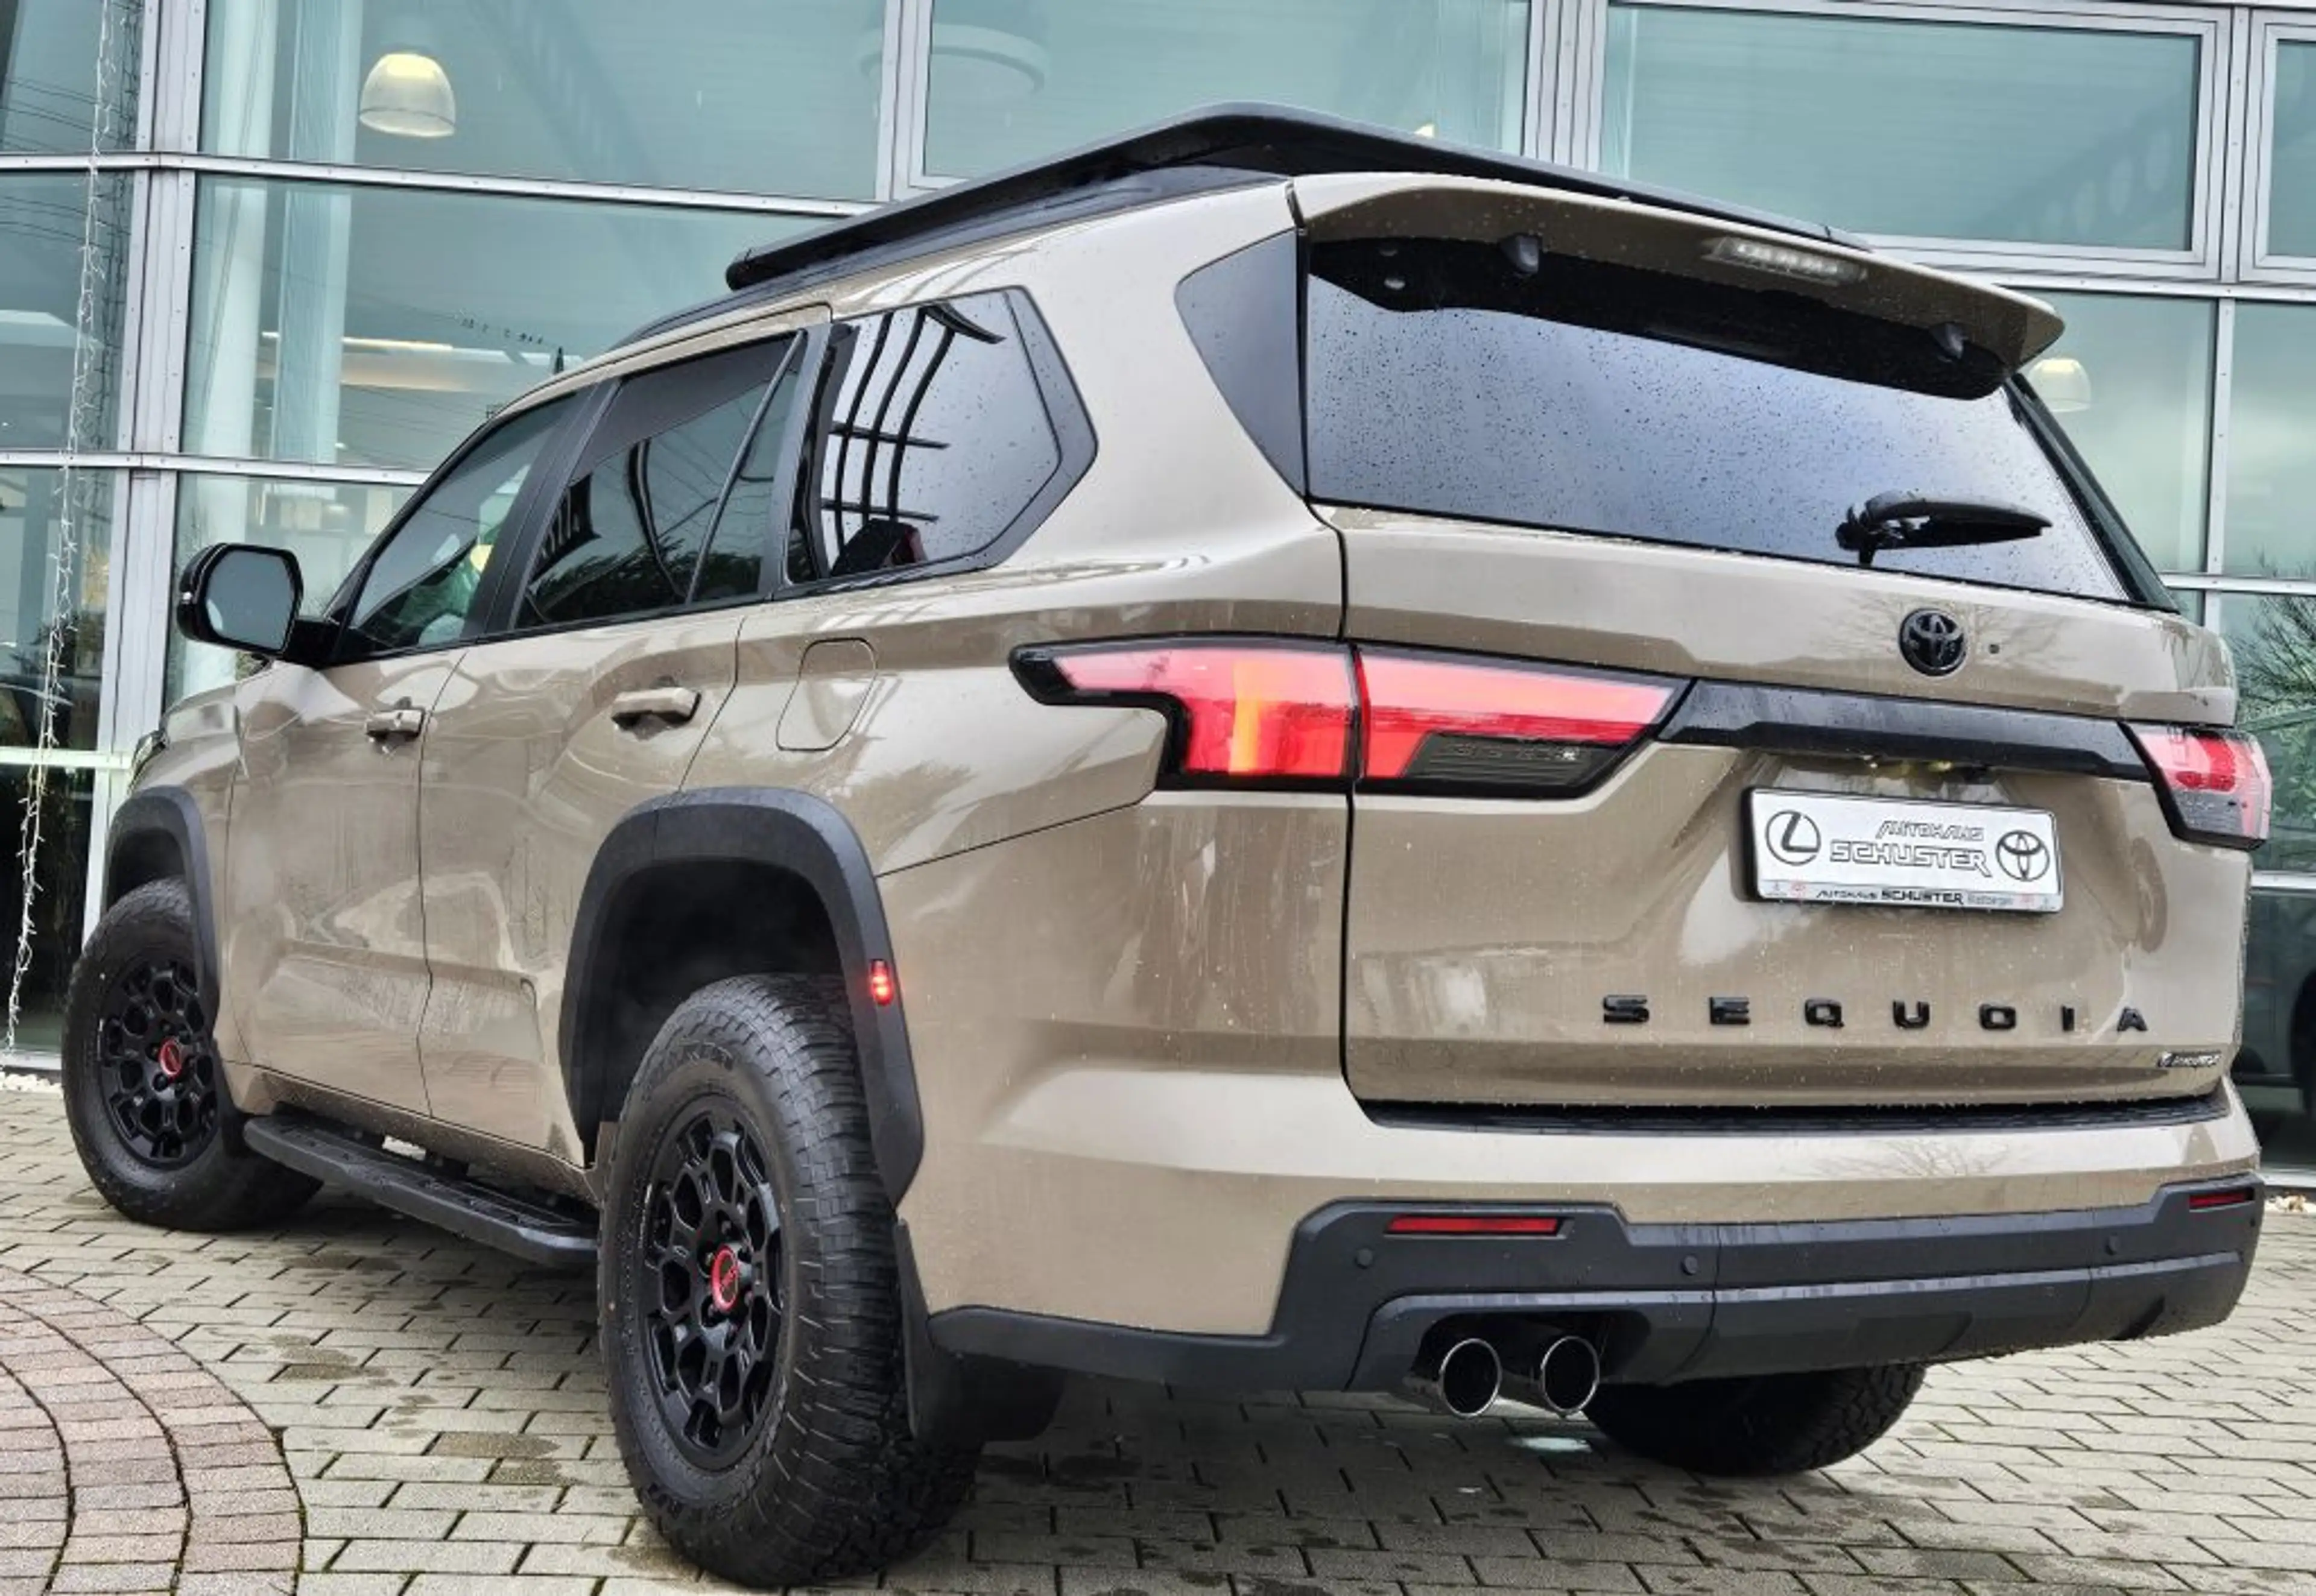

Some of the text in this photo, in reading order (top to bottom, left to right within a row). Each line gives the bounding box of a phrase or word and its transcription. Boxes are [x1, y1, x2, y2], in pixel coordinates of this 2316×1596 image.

[1875, 820, 1985, 842] AUTOHAUS
[1830, 840, 1992, 877] SCHUSTER
[1881, 890, 1964, 904] SCHUSTER
[1603, 995, 2148, 1032] SEQUOIA
